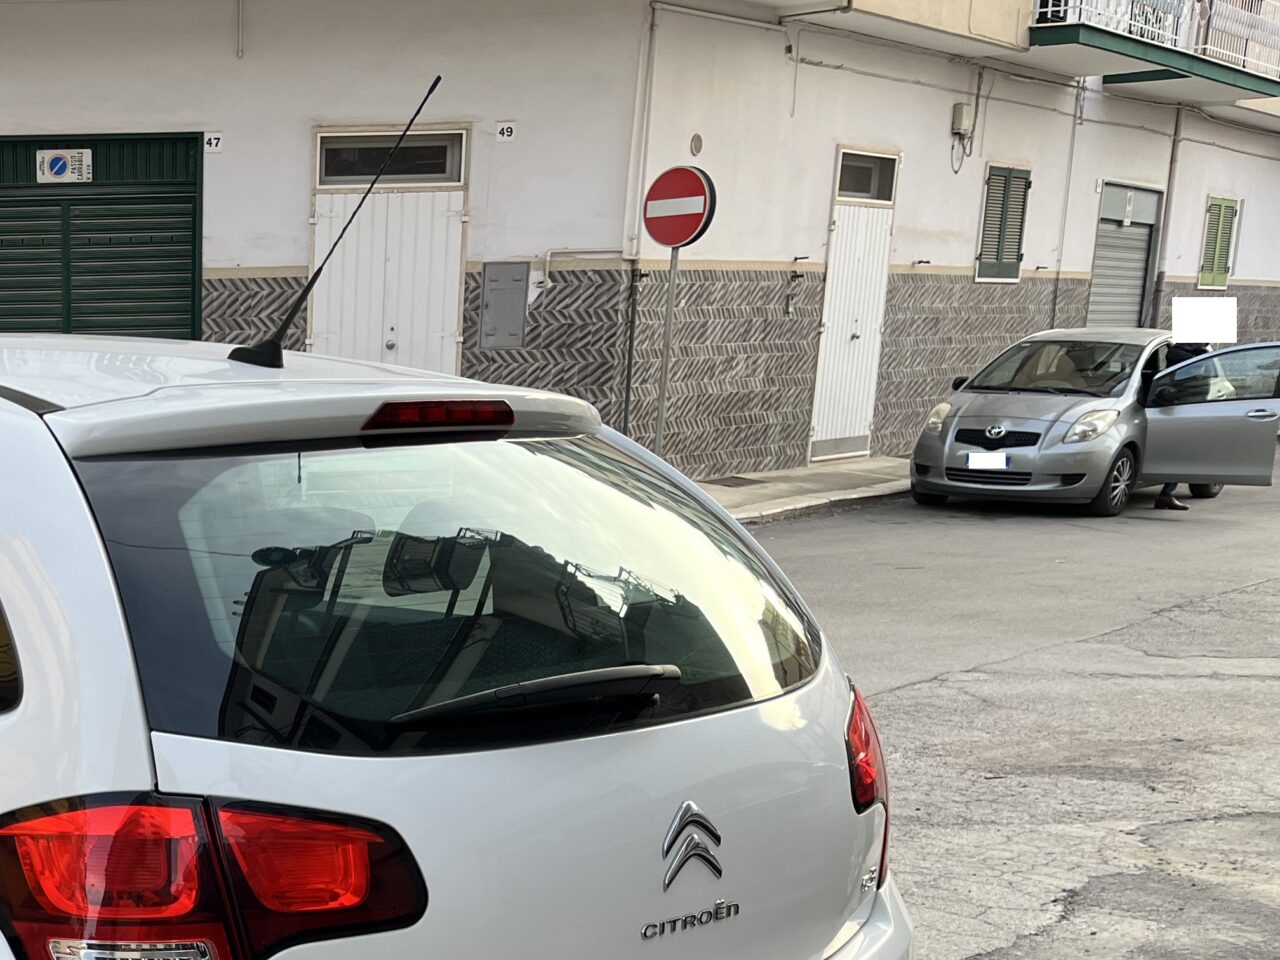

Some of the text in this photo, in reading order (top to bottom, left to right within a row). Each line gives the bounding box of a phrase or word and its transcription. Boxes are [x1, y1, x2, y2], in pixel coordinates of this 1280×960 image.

[498, 126, 514, 138] 49
[205, 137, 221, 148] 47
[76, 151, 84, 181] CARRABILE
